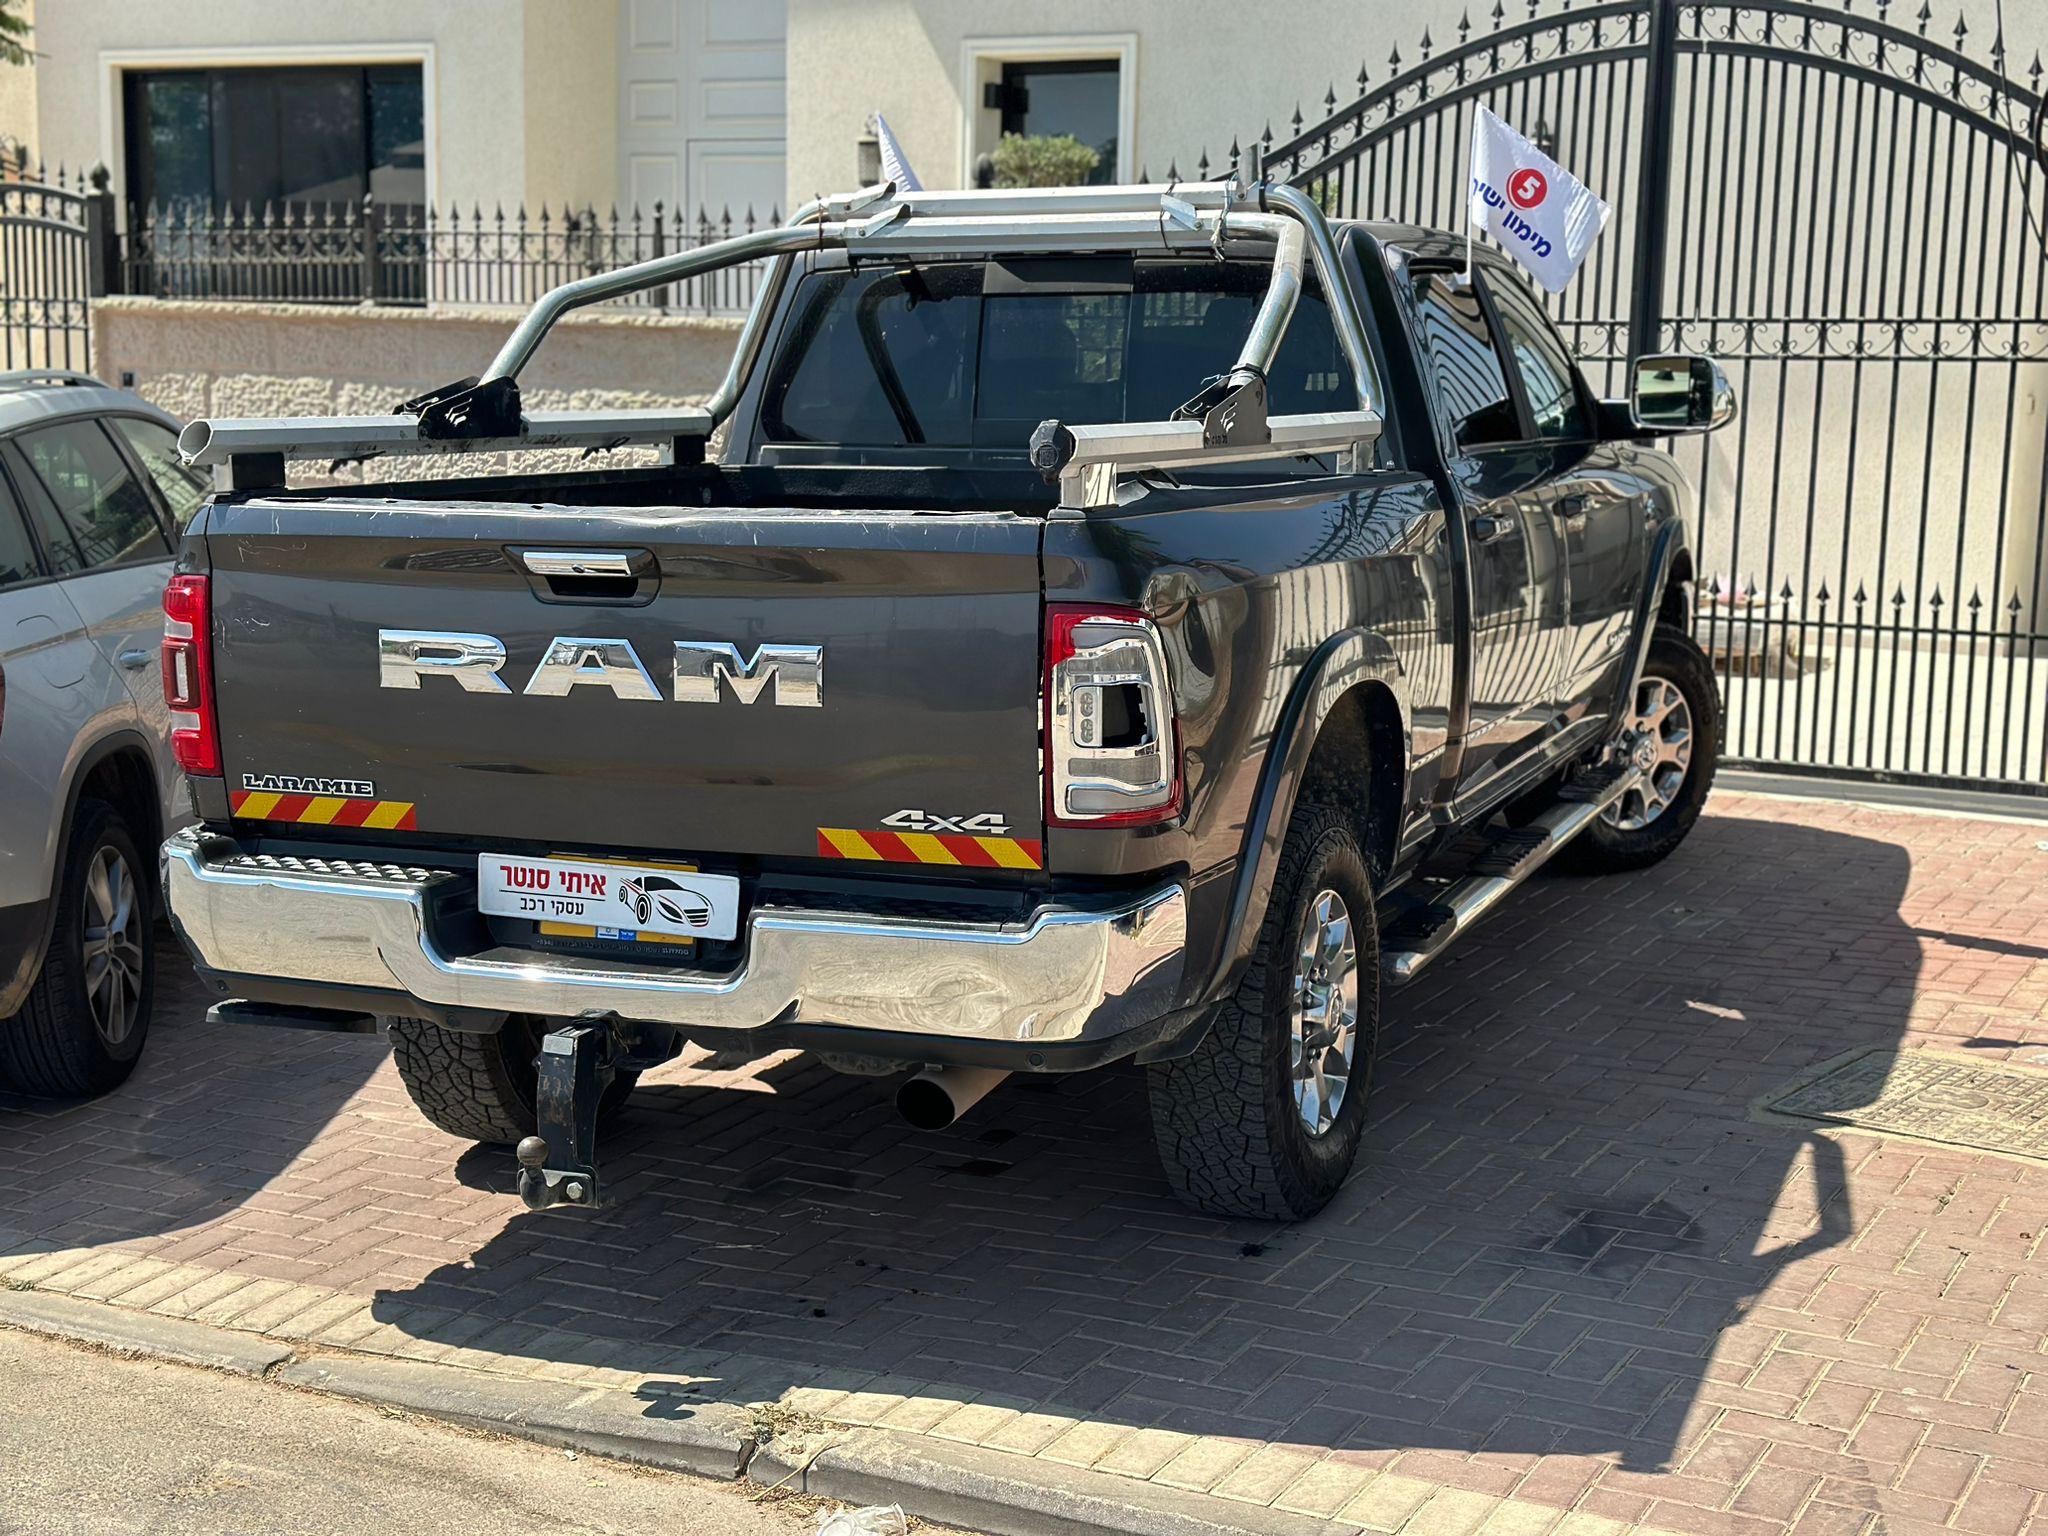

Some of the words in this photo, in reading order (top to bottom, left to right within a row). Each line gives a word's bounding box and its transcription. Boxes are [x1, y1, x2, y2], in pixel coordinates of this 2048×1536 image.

[1517, 175, 1541, 200] 5
[1502, 210, 1552, 258] מימון
[379, 629, 824, 708] RAM
[243, 774, 374, 797] LARAMIE
[500, 865, 550, 890] סנטר
[558, 870, 607, 896] איתי
[520, 897, 545, 911] רכב
[551, 899, 584, 916] עסקי
